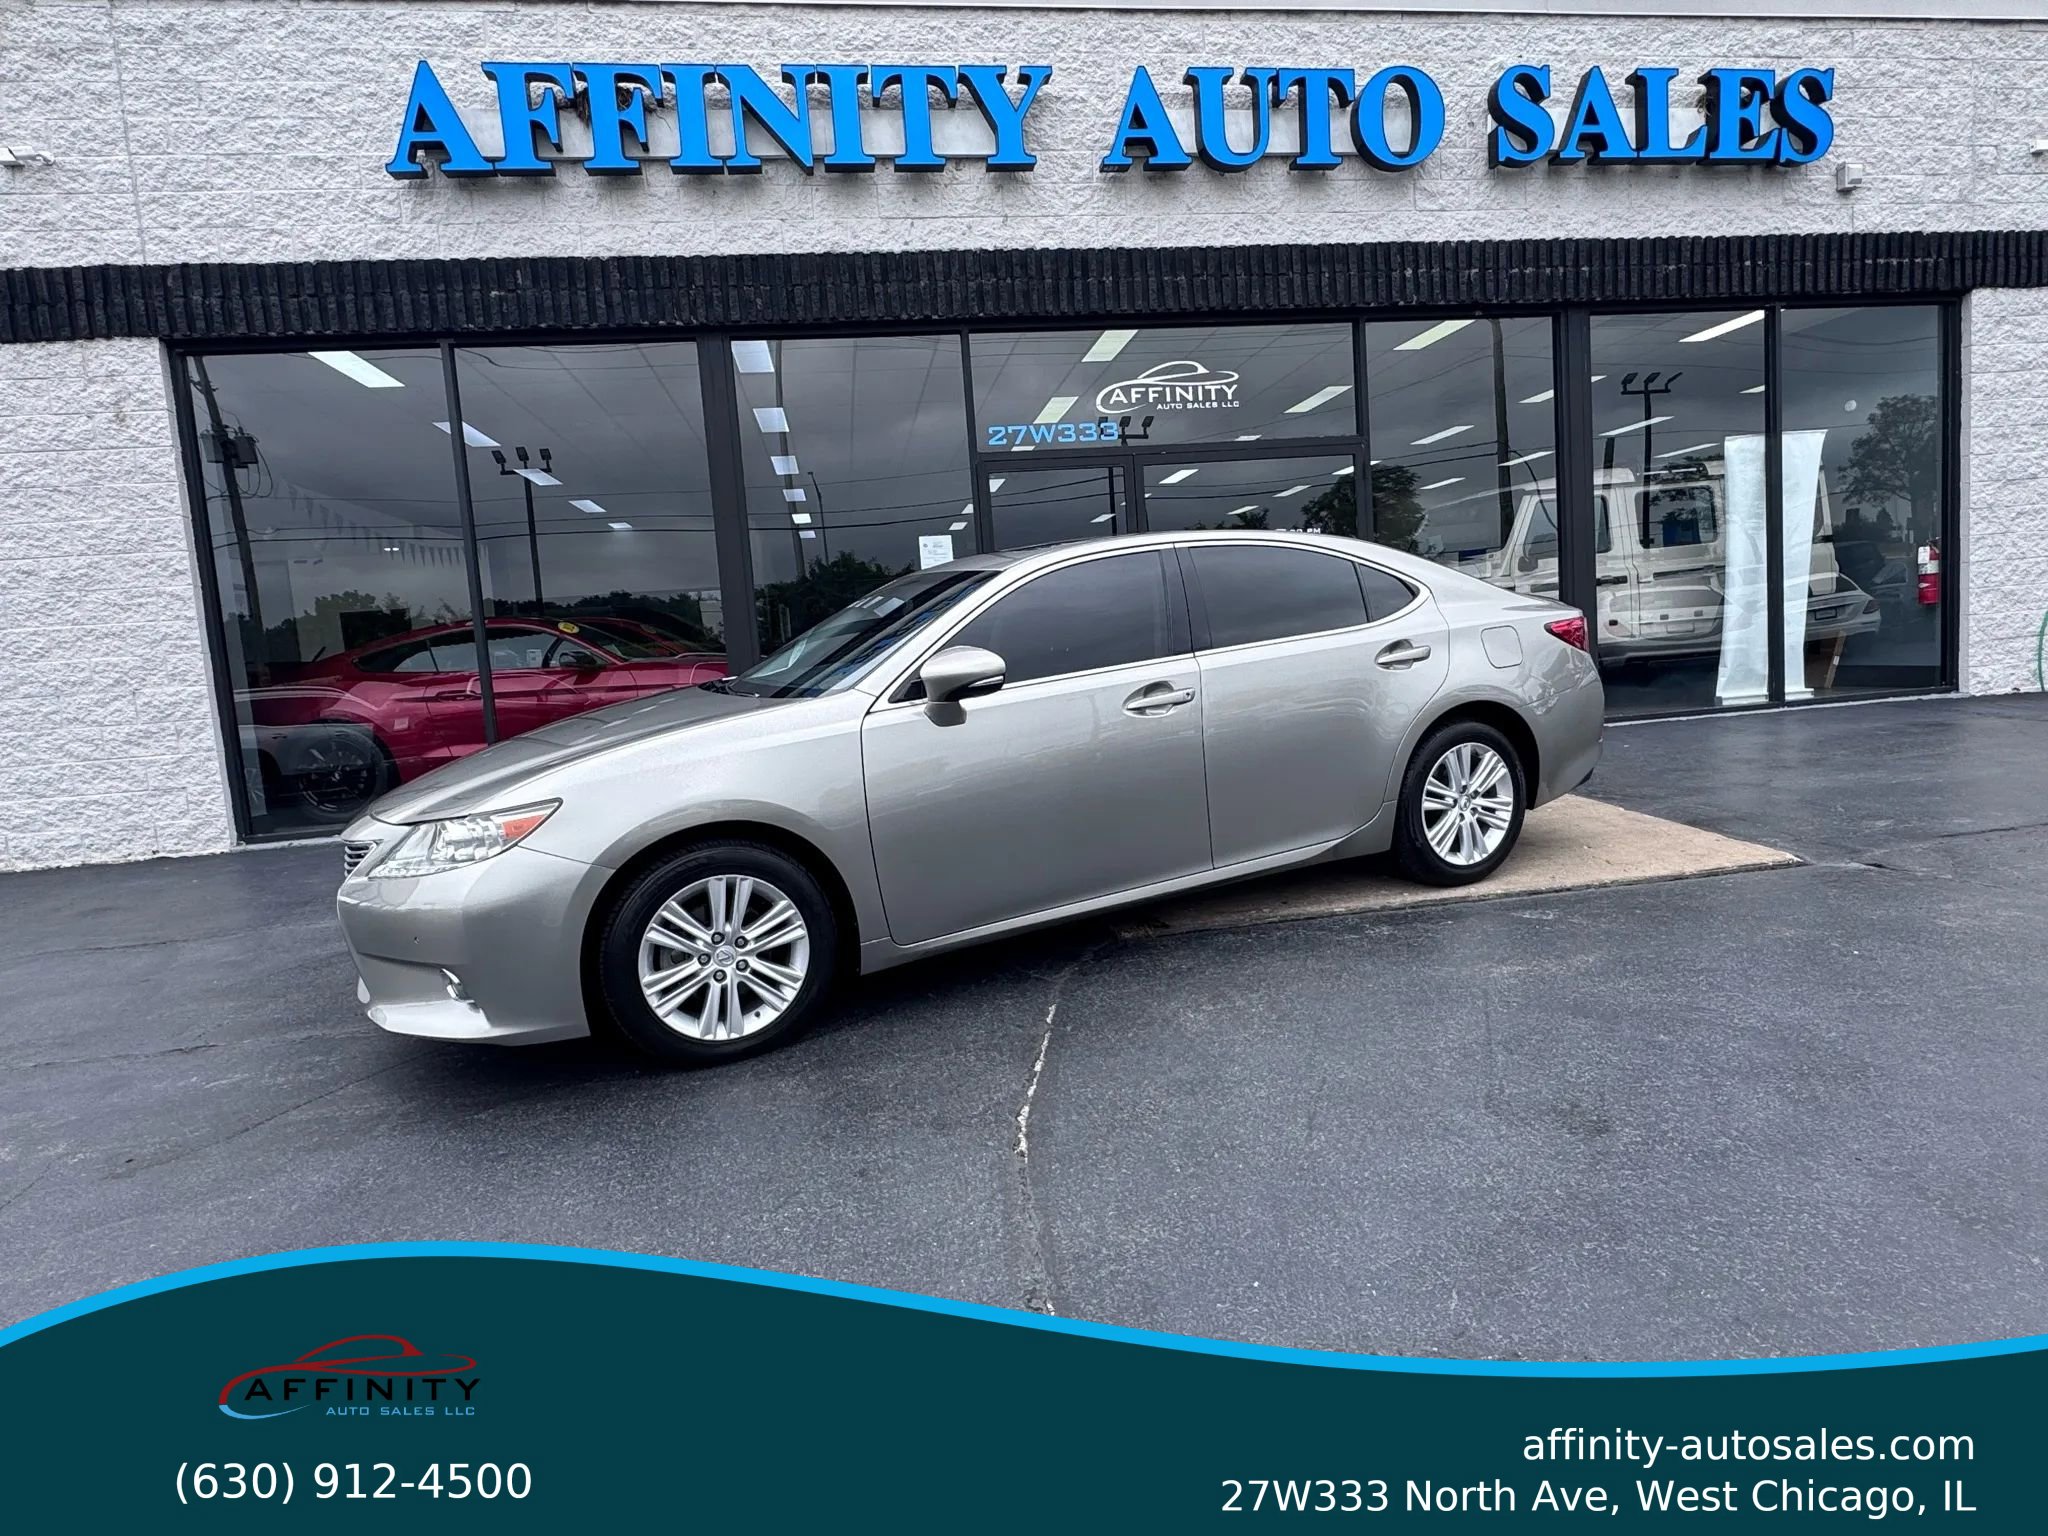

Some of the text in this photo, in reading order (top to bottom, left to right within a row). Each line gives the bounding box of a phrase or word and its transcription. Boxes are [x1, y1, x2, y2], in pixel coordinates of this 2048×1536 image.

[386, 60, 1836, 174] AFFINITY AUTO SALES
[1109, 384, 1238, 405] AFFINITY
[1156, 400, 1240, 410] AUTO SALES LLC
[988, 422, 1119, 446] 27W333
